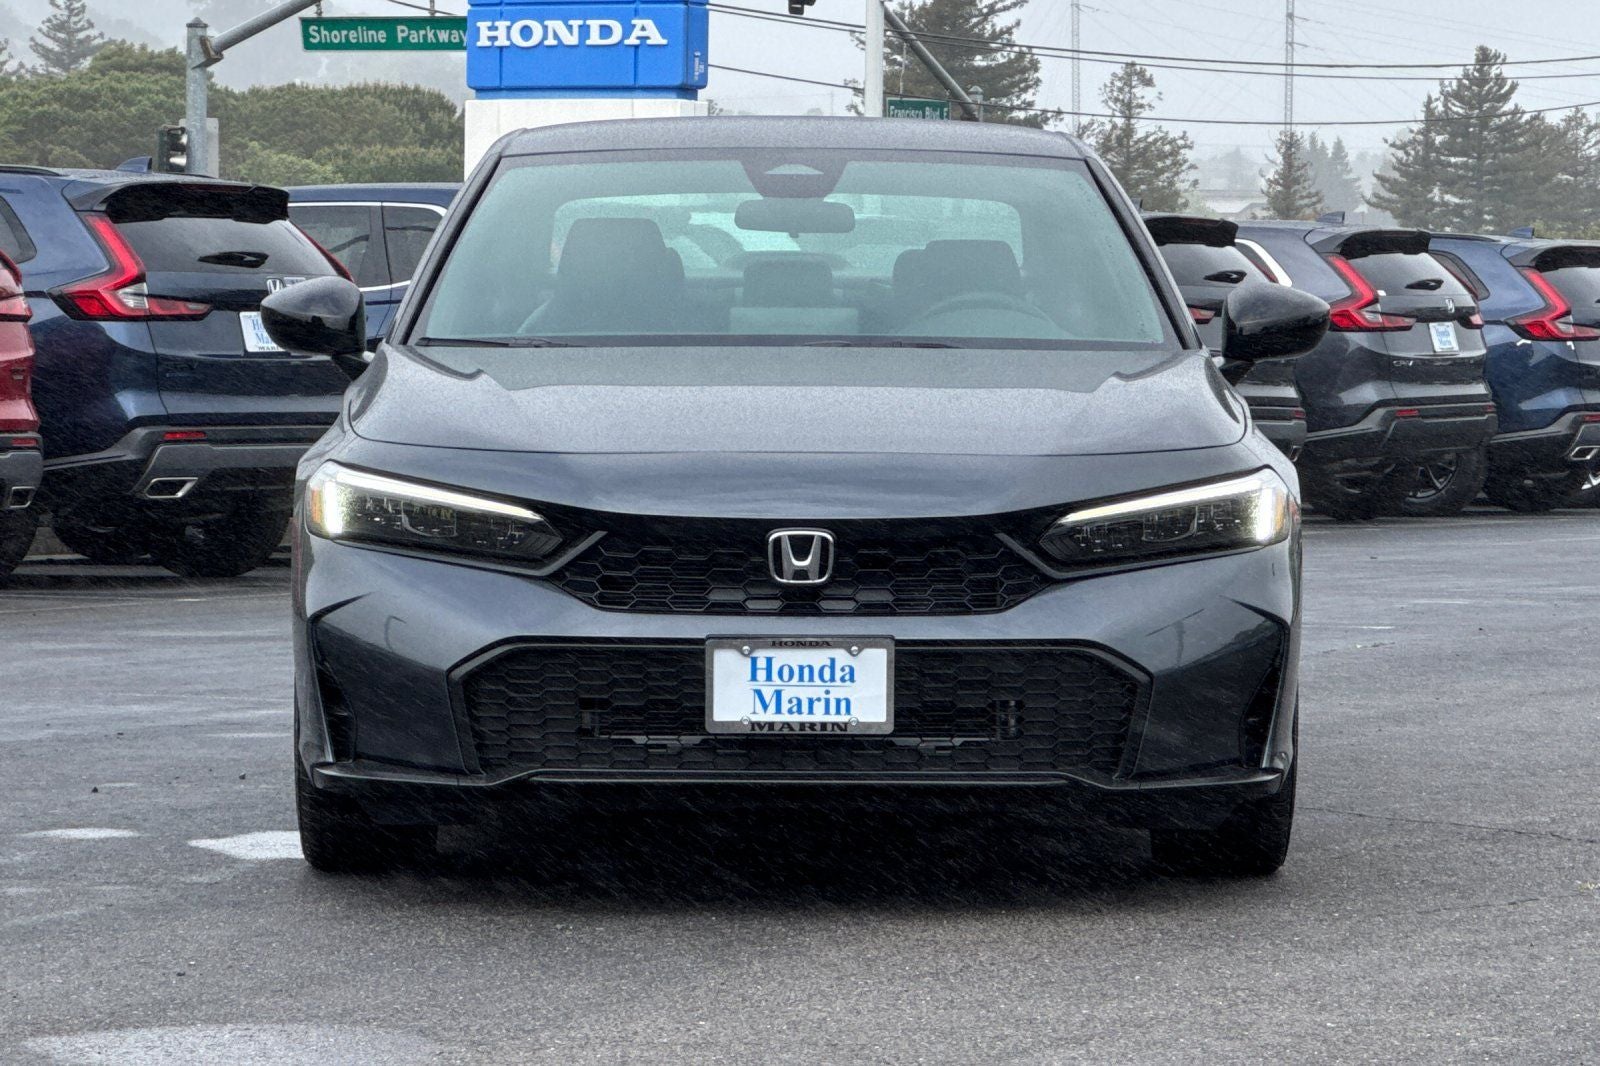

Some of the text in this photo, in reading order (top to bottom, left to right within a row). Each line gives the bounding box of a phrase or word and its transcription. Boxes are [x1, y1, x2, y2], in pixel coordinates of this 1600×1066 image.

[308, 26, 467, 47] Shoreline Parkway
[476, 20, 669, 47] HONDA
[748, 656, 857, 684] Honda
[750, 688, 853, 716] Marin
[750, 721, 849, 732] MARIN
